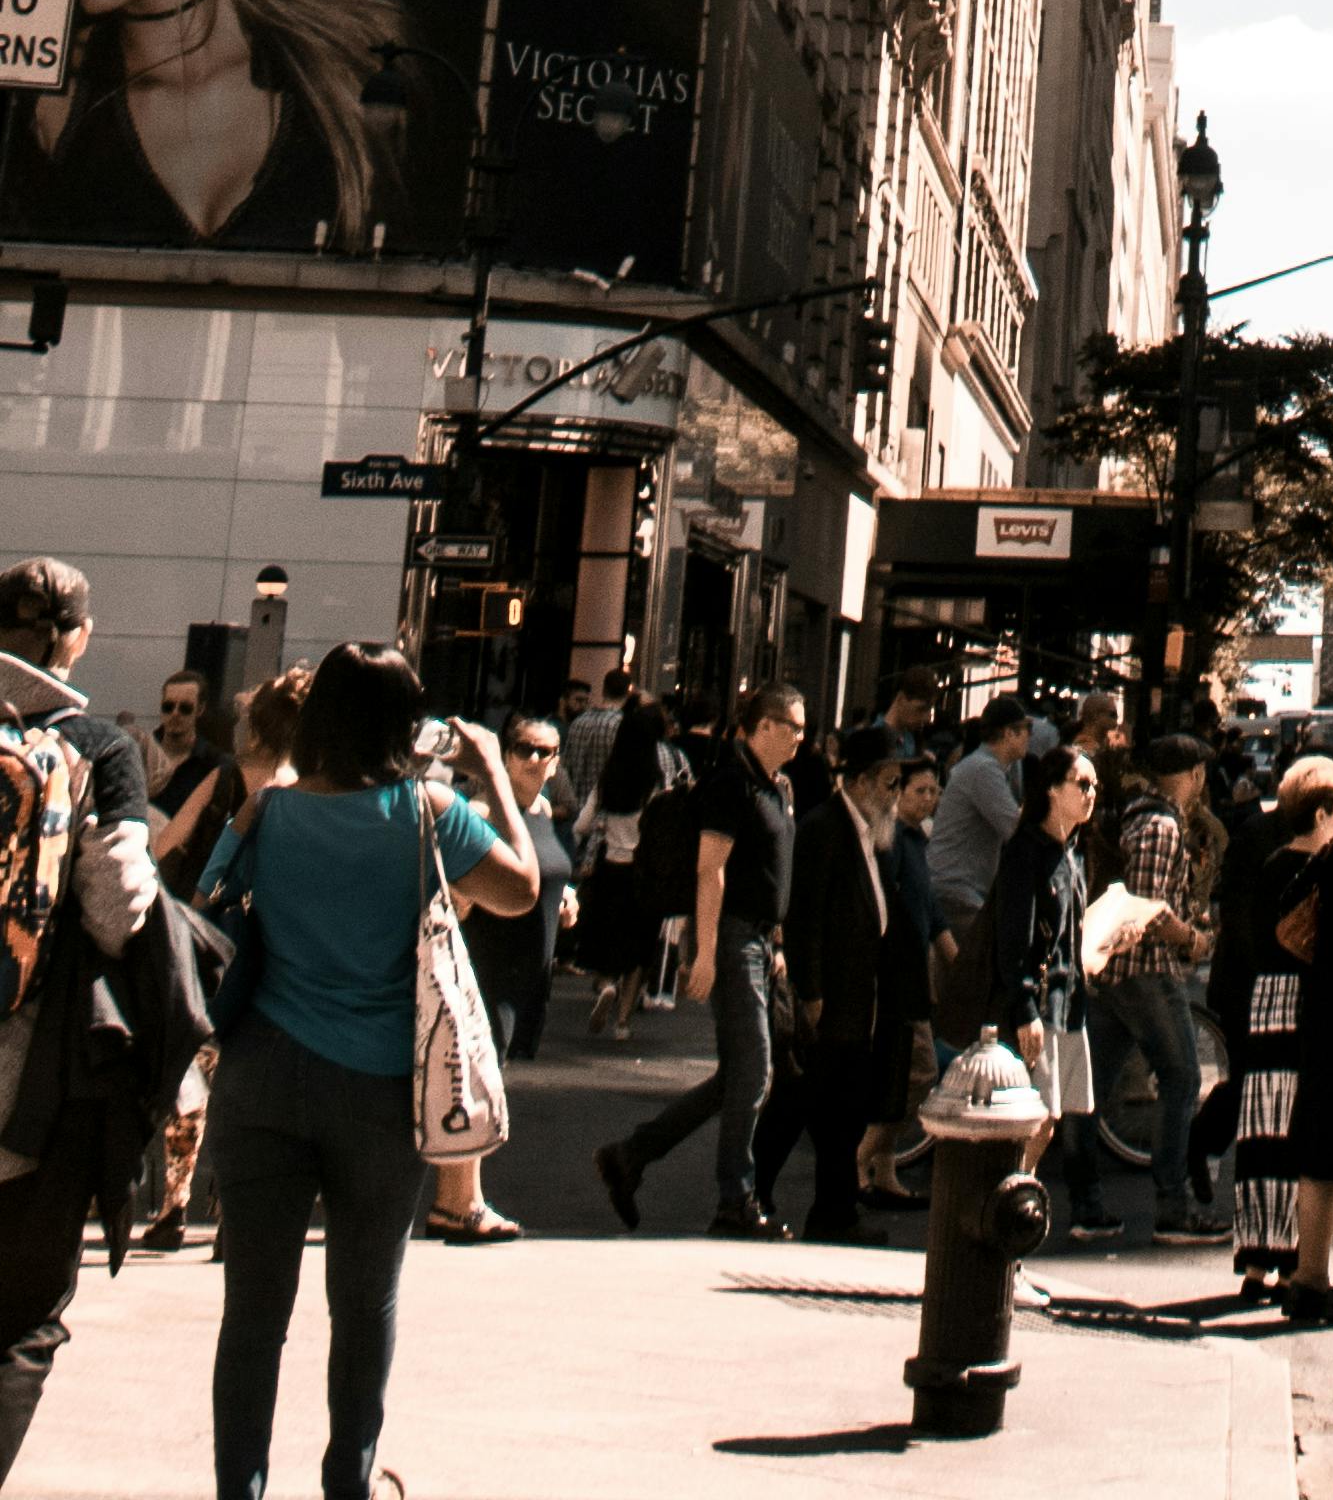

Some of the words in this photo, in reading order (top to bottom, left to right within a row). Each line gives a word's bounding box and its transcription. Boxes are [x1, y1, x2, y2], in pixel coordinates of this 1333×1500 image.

[506, 41, 690, 104] VICTOIA'S
[537, 88, 659, 135] SECT
[340, 470, 385, 490] Sixth
[388, 470, 424, 491] Ave
